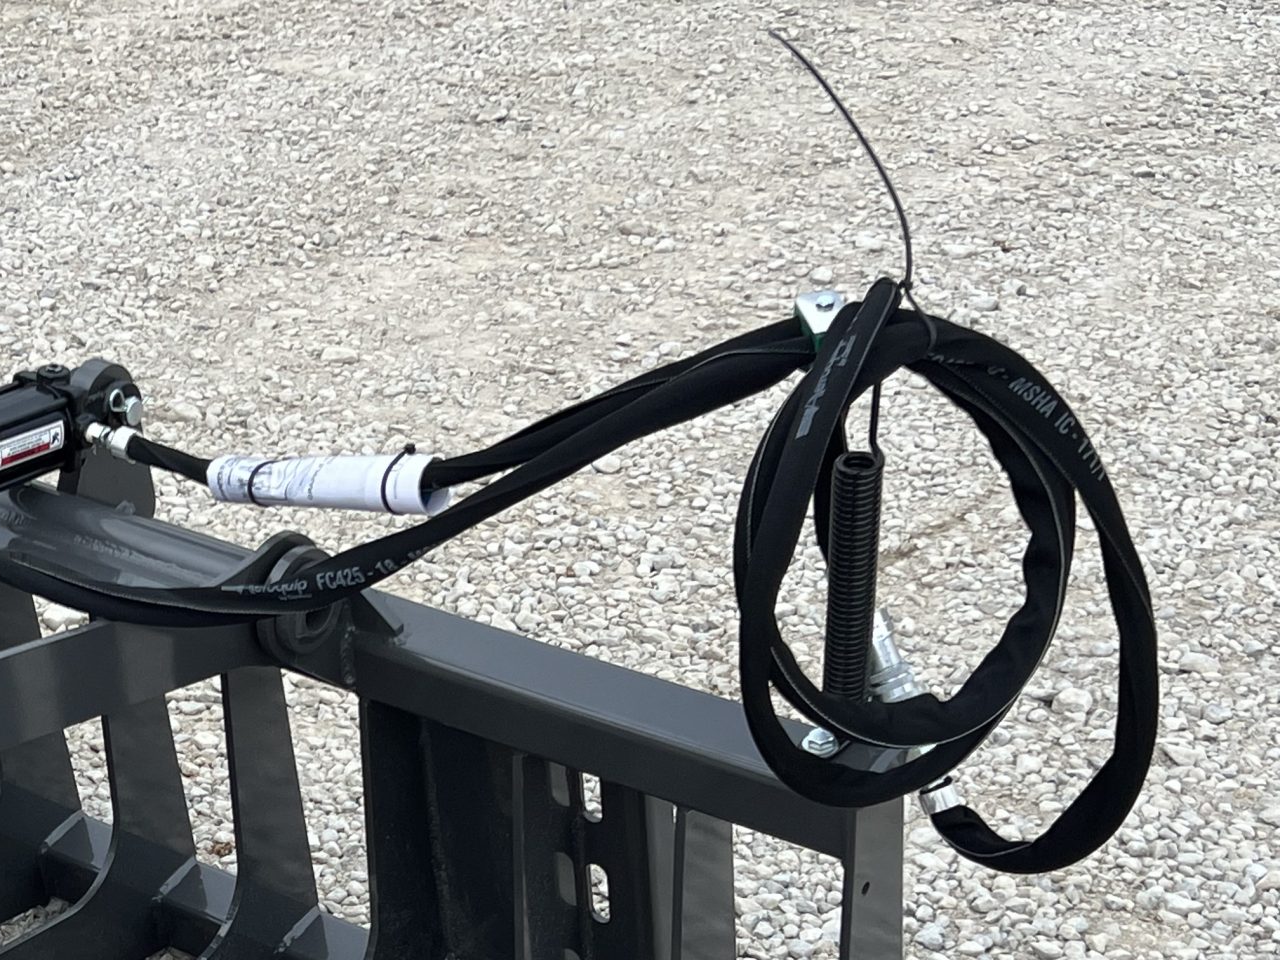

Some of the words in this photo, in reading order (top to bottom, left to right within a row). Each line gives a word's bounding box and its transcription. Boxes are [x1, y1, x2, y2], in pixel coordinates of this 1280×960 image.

[1008, 377, 1058, 418] MSHA
[1054, 412, 1075, 434] IC
[316, 567, 365, 591] FC425
